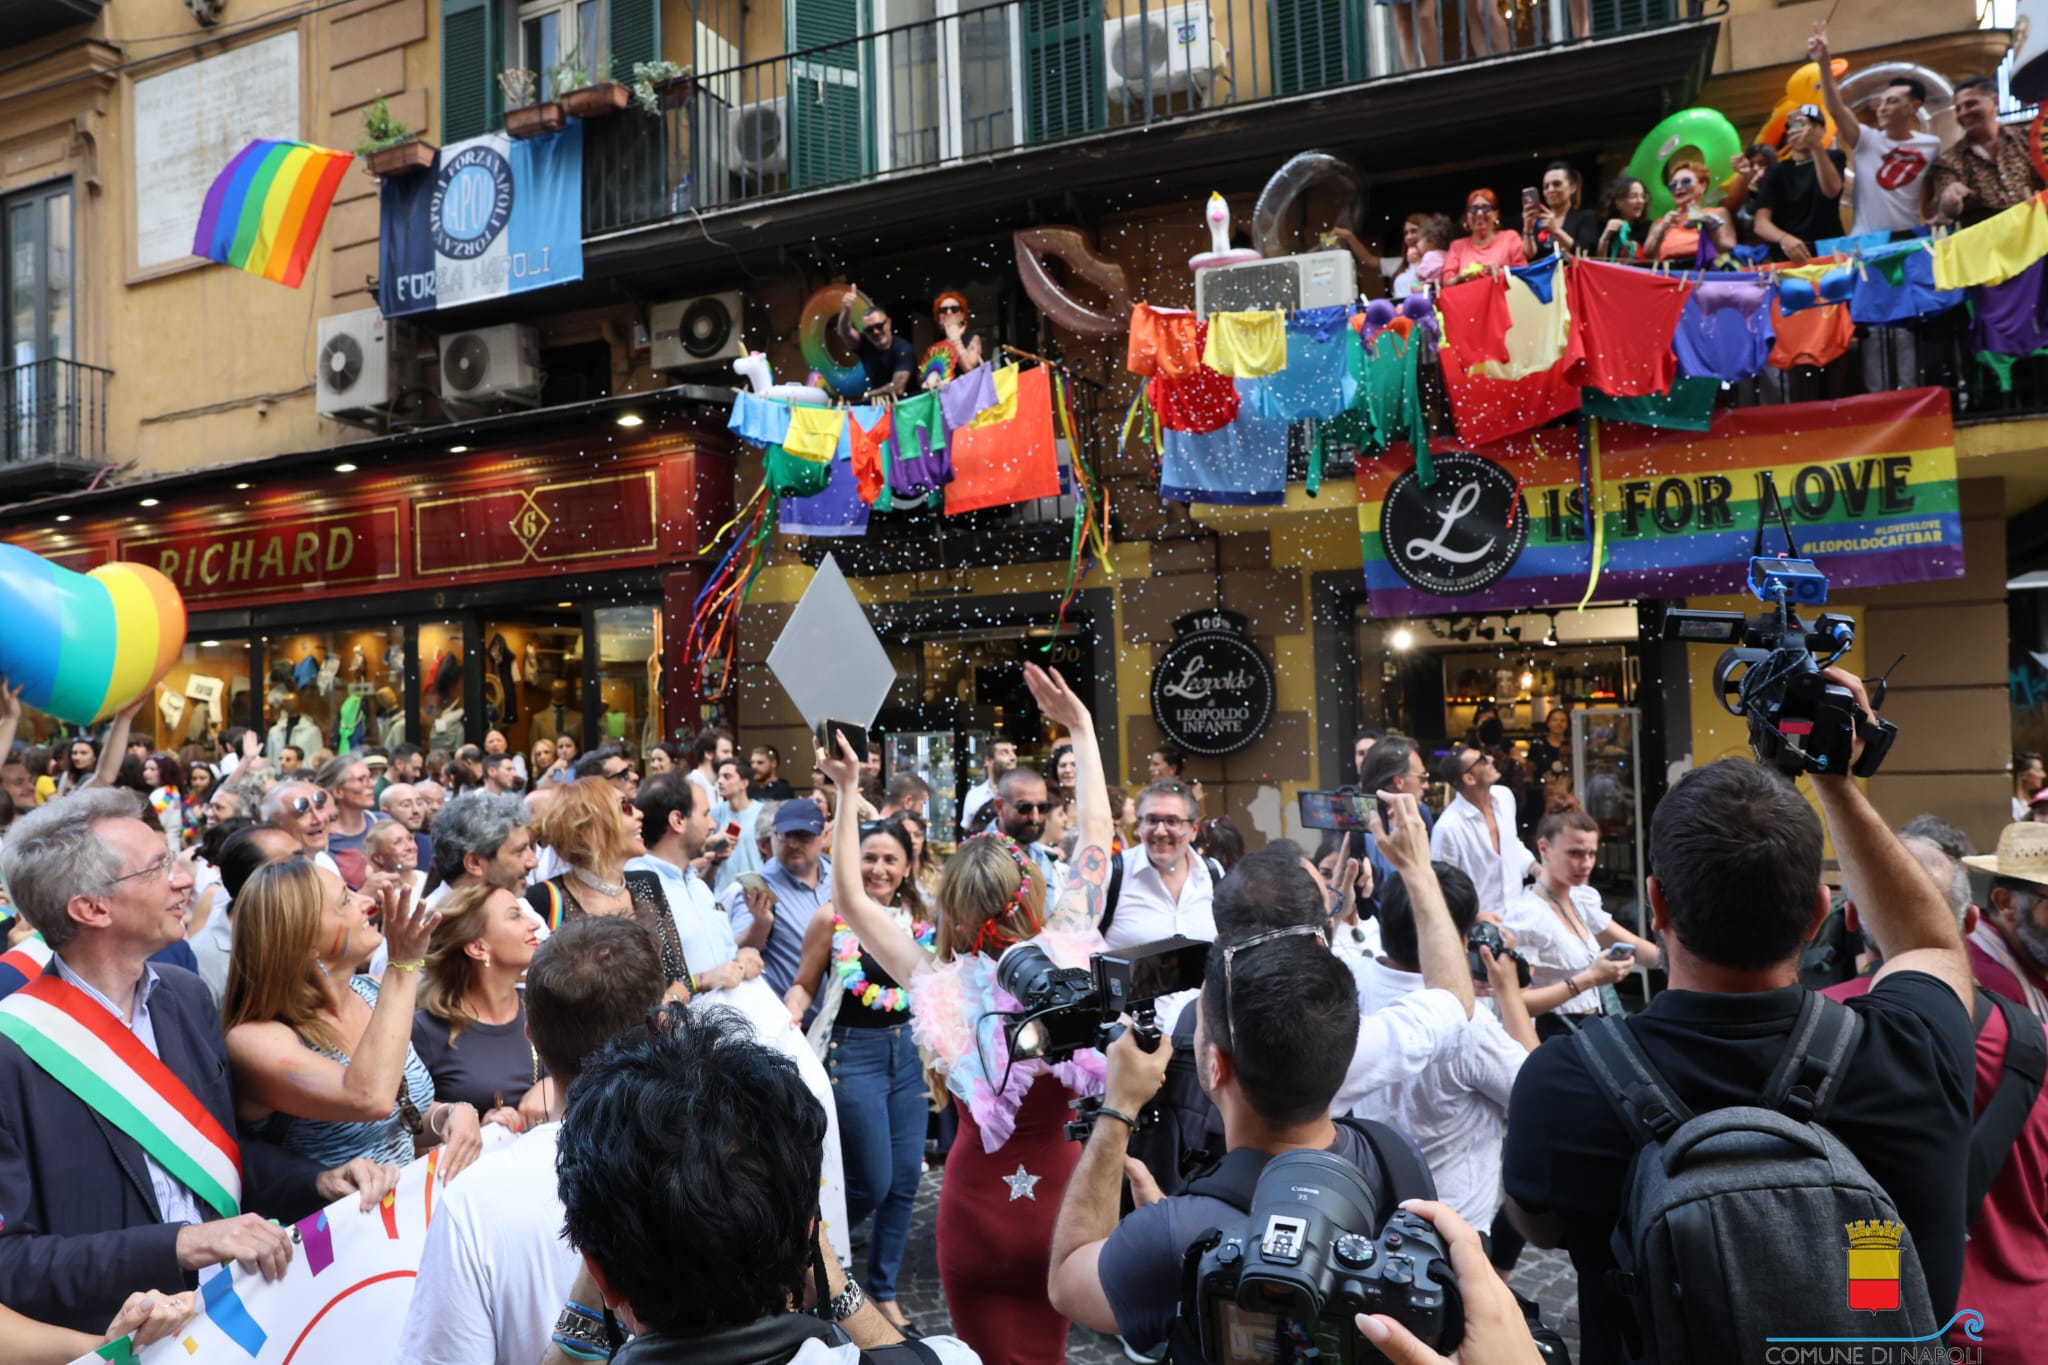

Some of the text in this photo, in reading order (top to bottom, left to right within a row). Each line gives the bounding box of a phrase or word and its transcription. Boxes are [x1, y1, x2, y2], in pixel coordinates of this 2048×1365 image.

[1618, 473, 1735, 537] FOR
[1753, 455, 1916, 526] LOVE
[522, 511, 537, 539] 6
[1875, 520, 1941, 535] #LOVEISLOVE
[1802, 530, 1942, 554] #LEOPOLDOCAFEBAR
[159, 527, 355, 587] RICHARD
[1193, 616, 1232, 630] 100%
[1163, 655, 1256, 700] Leopoldo
[1176, 708, 1249, 722] LEOPOLDO
[1183, 720, 1242, 734] INFANTE
[1291, 1185, 1320, 1195] Canon
